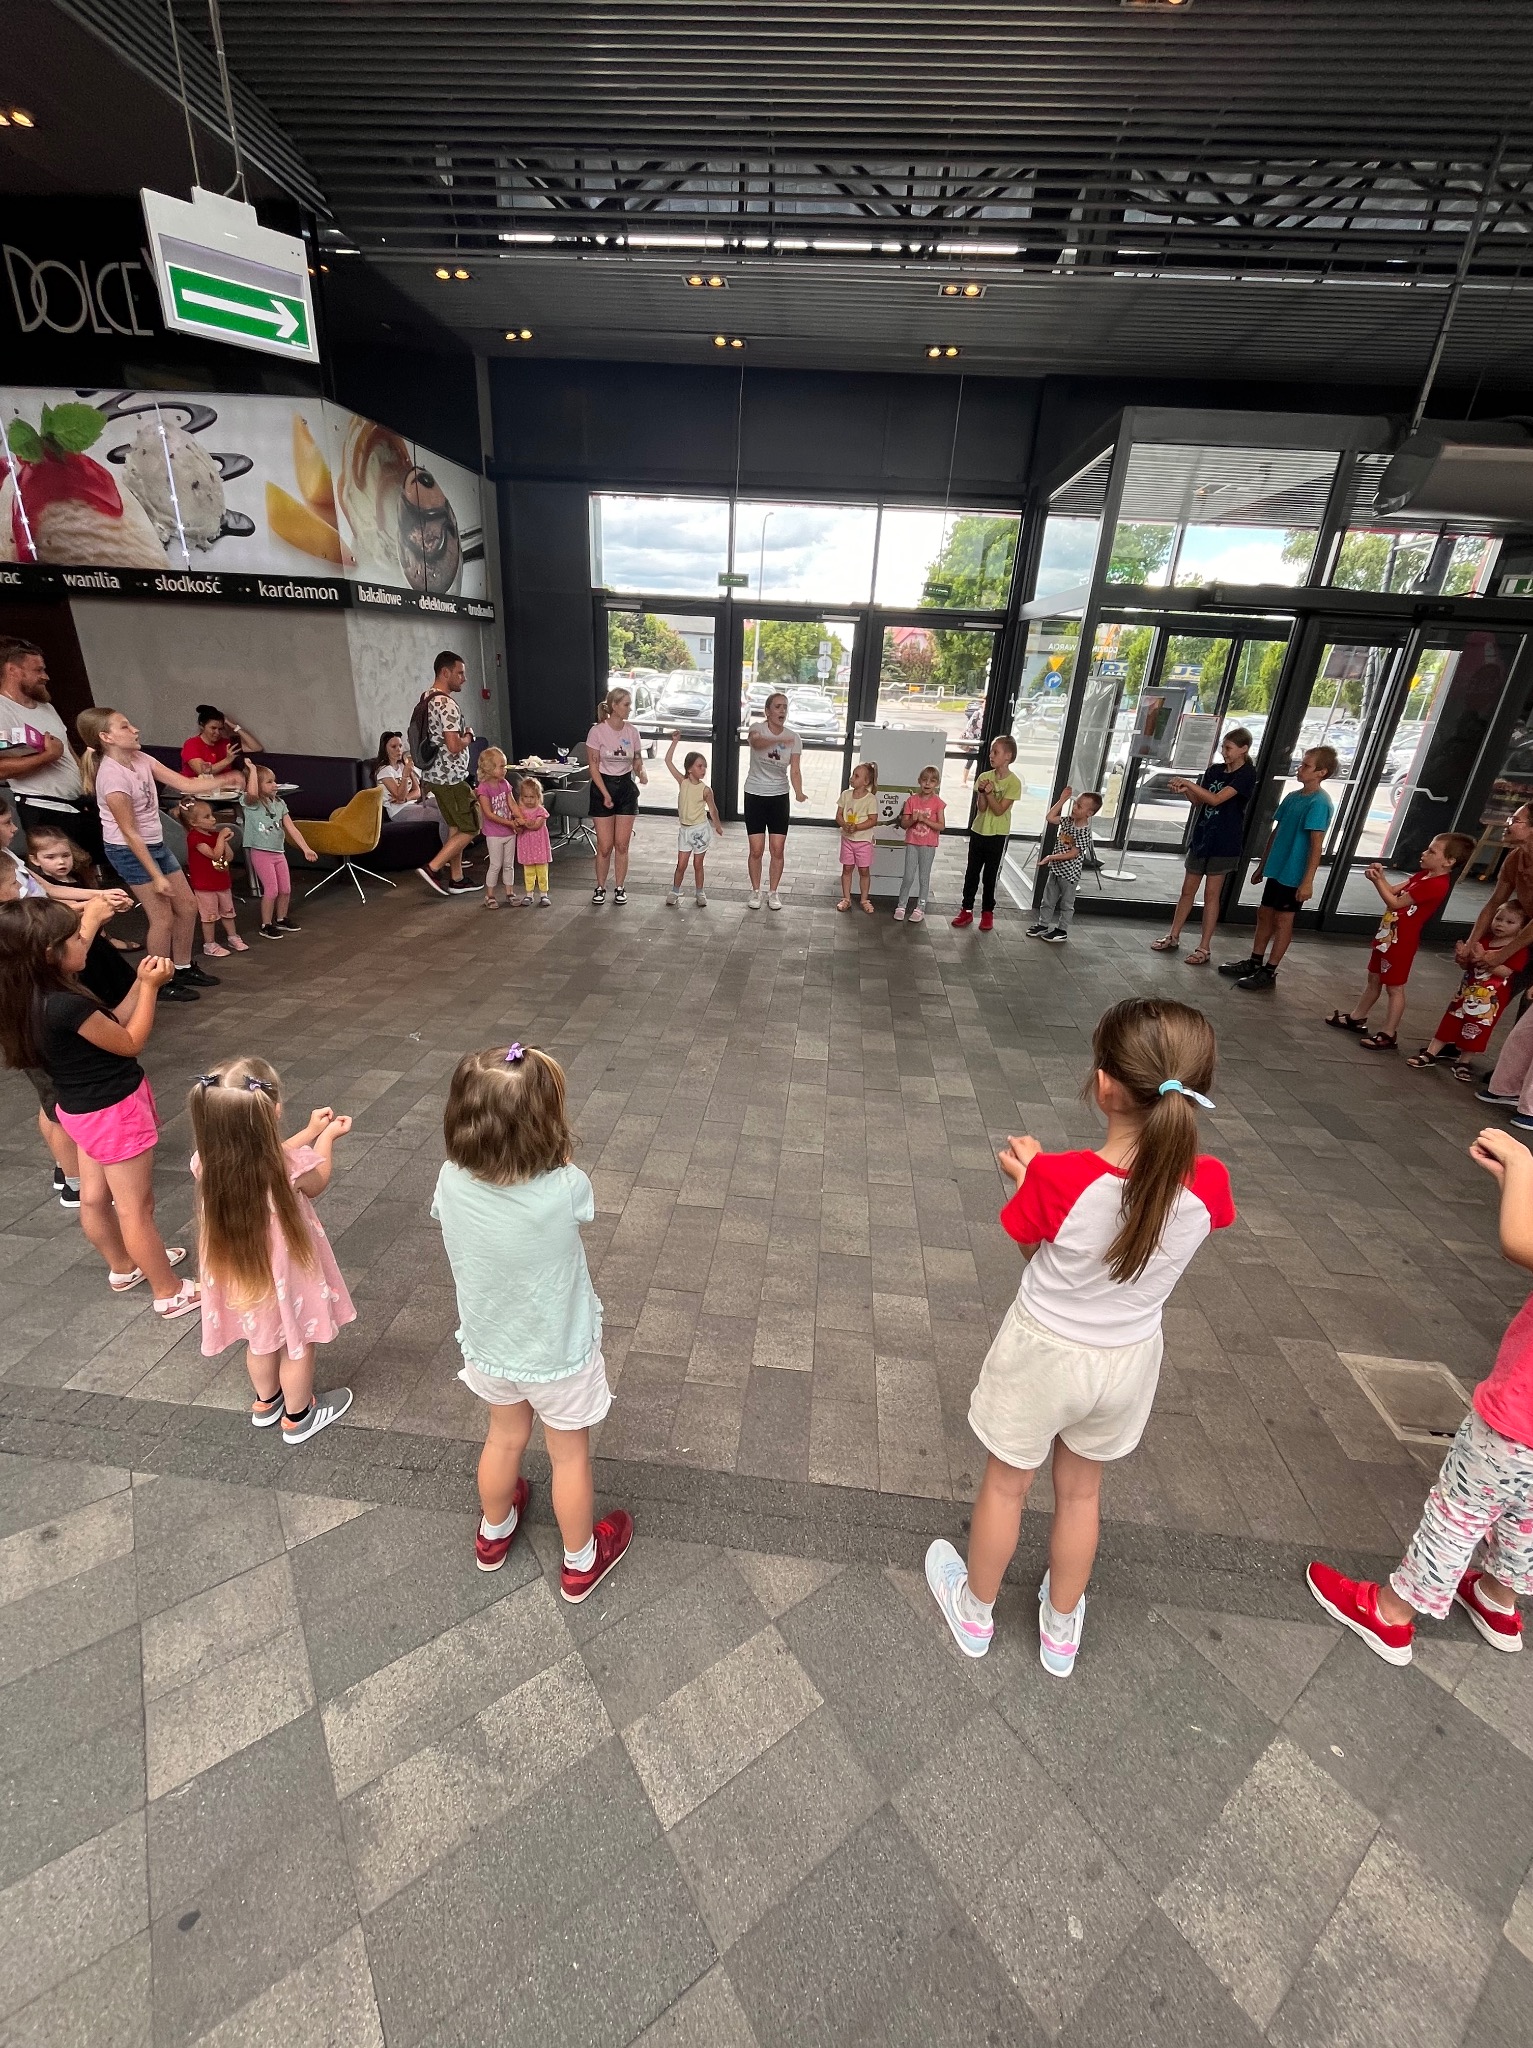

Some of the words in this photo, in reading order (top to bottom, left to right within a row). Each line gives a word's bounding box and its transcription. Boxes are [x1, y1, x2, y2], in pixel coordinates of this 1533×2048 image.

[2, 244, 154, 336] DOLCE
[62, 571, 121, 589] wanilia
[257, 580, 340, 601] kardamon
[357, 585, 402, 606] bakaliowe
